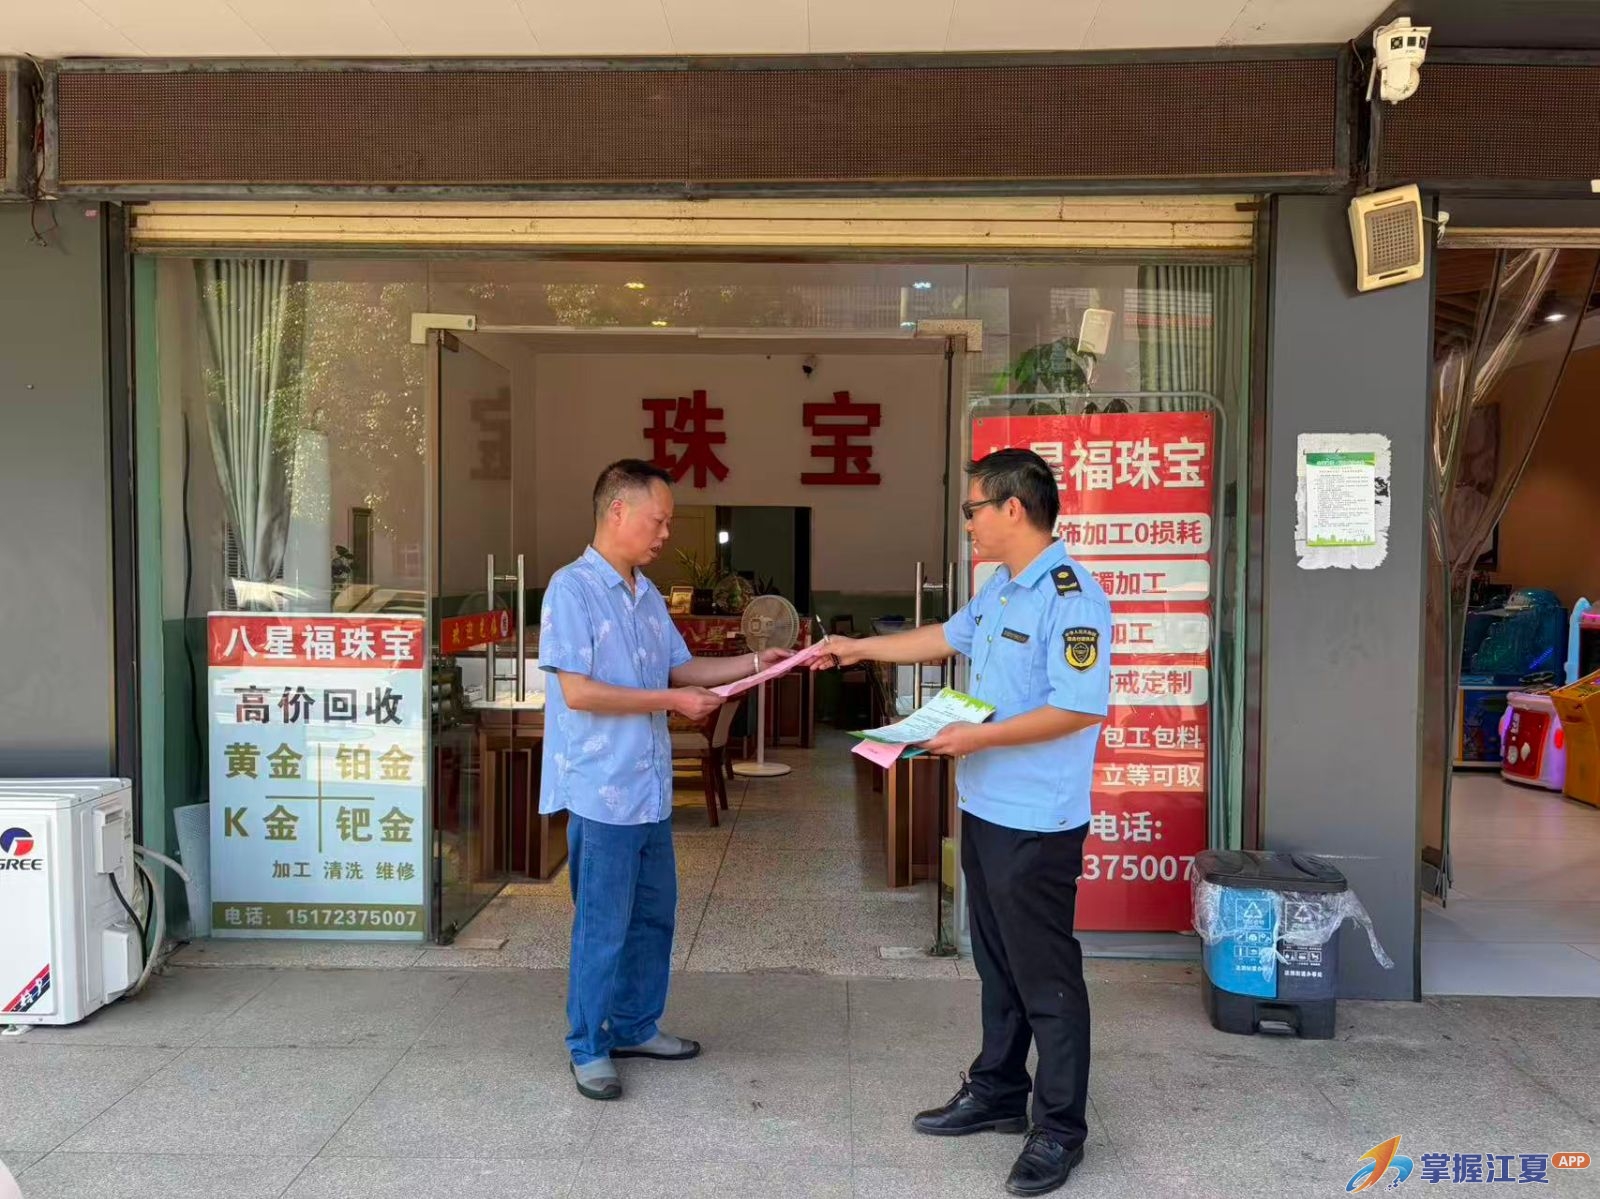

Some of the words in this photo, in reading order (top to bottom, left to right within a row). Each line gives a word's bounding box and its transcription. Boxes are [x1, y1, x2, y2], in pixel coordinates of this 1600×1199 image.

[223, 624, 415, 661] 八星福珠宝
[1109, 670, 1192, 694] 戒定制
[233, 685, 404, 724] 高价回收
[1102, 725, 1201, 749] 包工包料
[224, 743, 303, 780] 黄金
[335, 743, 415, 781] 铂金
[1102, 763, 1201, 787] 立等可取
[336, 806, 415, 843] 钯金
[272, 860, 311, 879] 加工
[324, 861, 363, 880] 清洗
[376, 862, 415, 881] 维修
[1076, 854, 1195, 881] 375007
[286, 909, 417, 927] 15172375007
